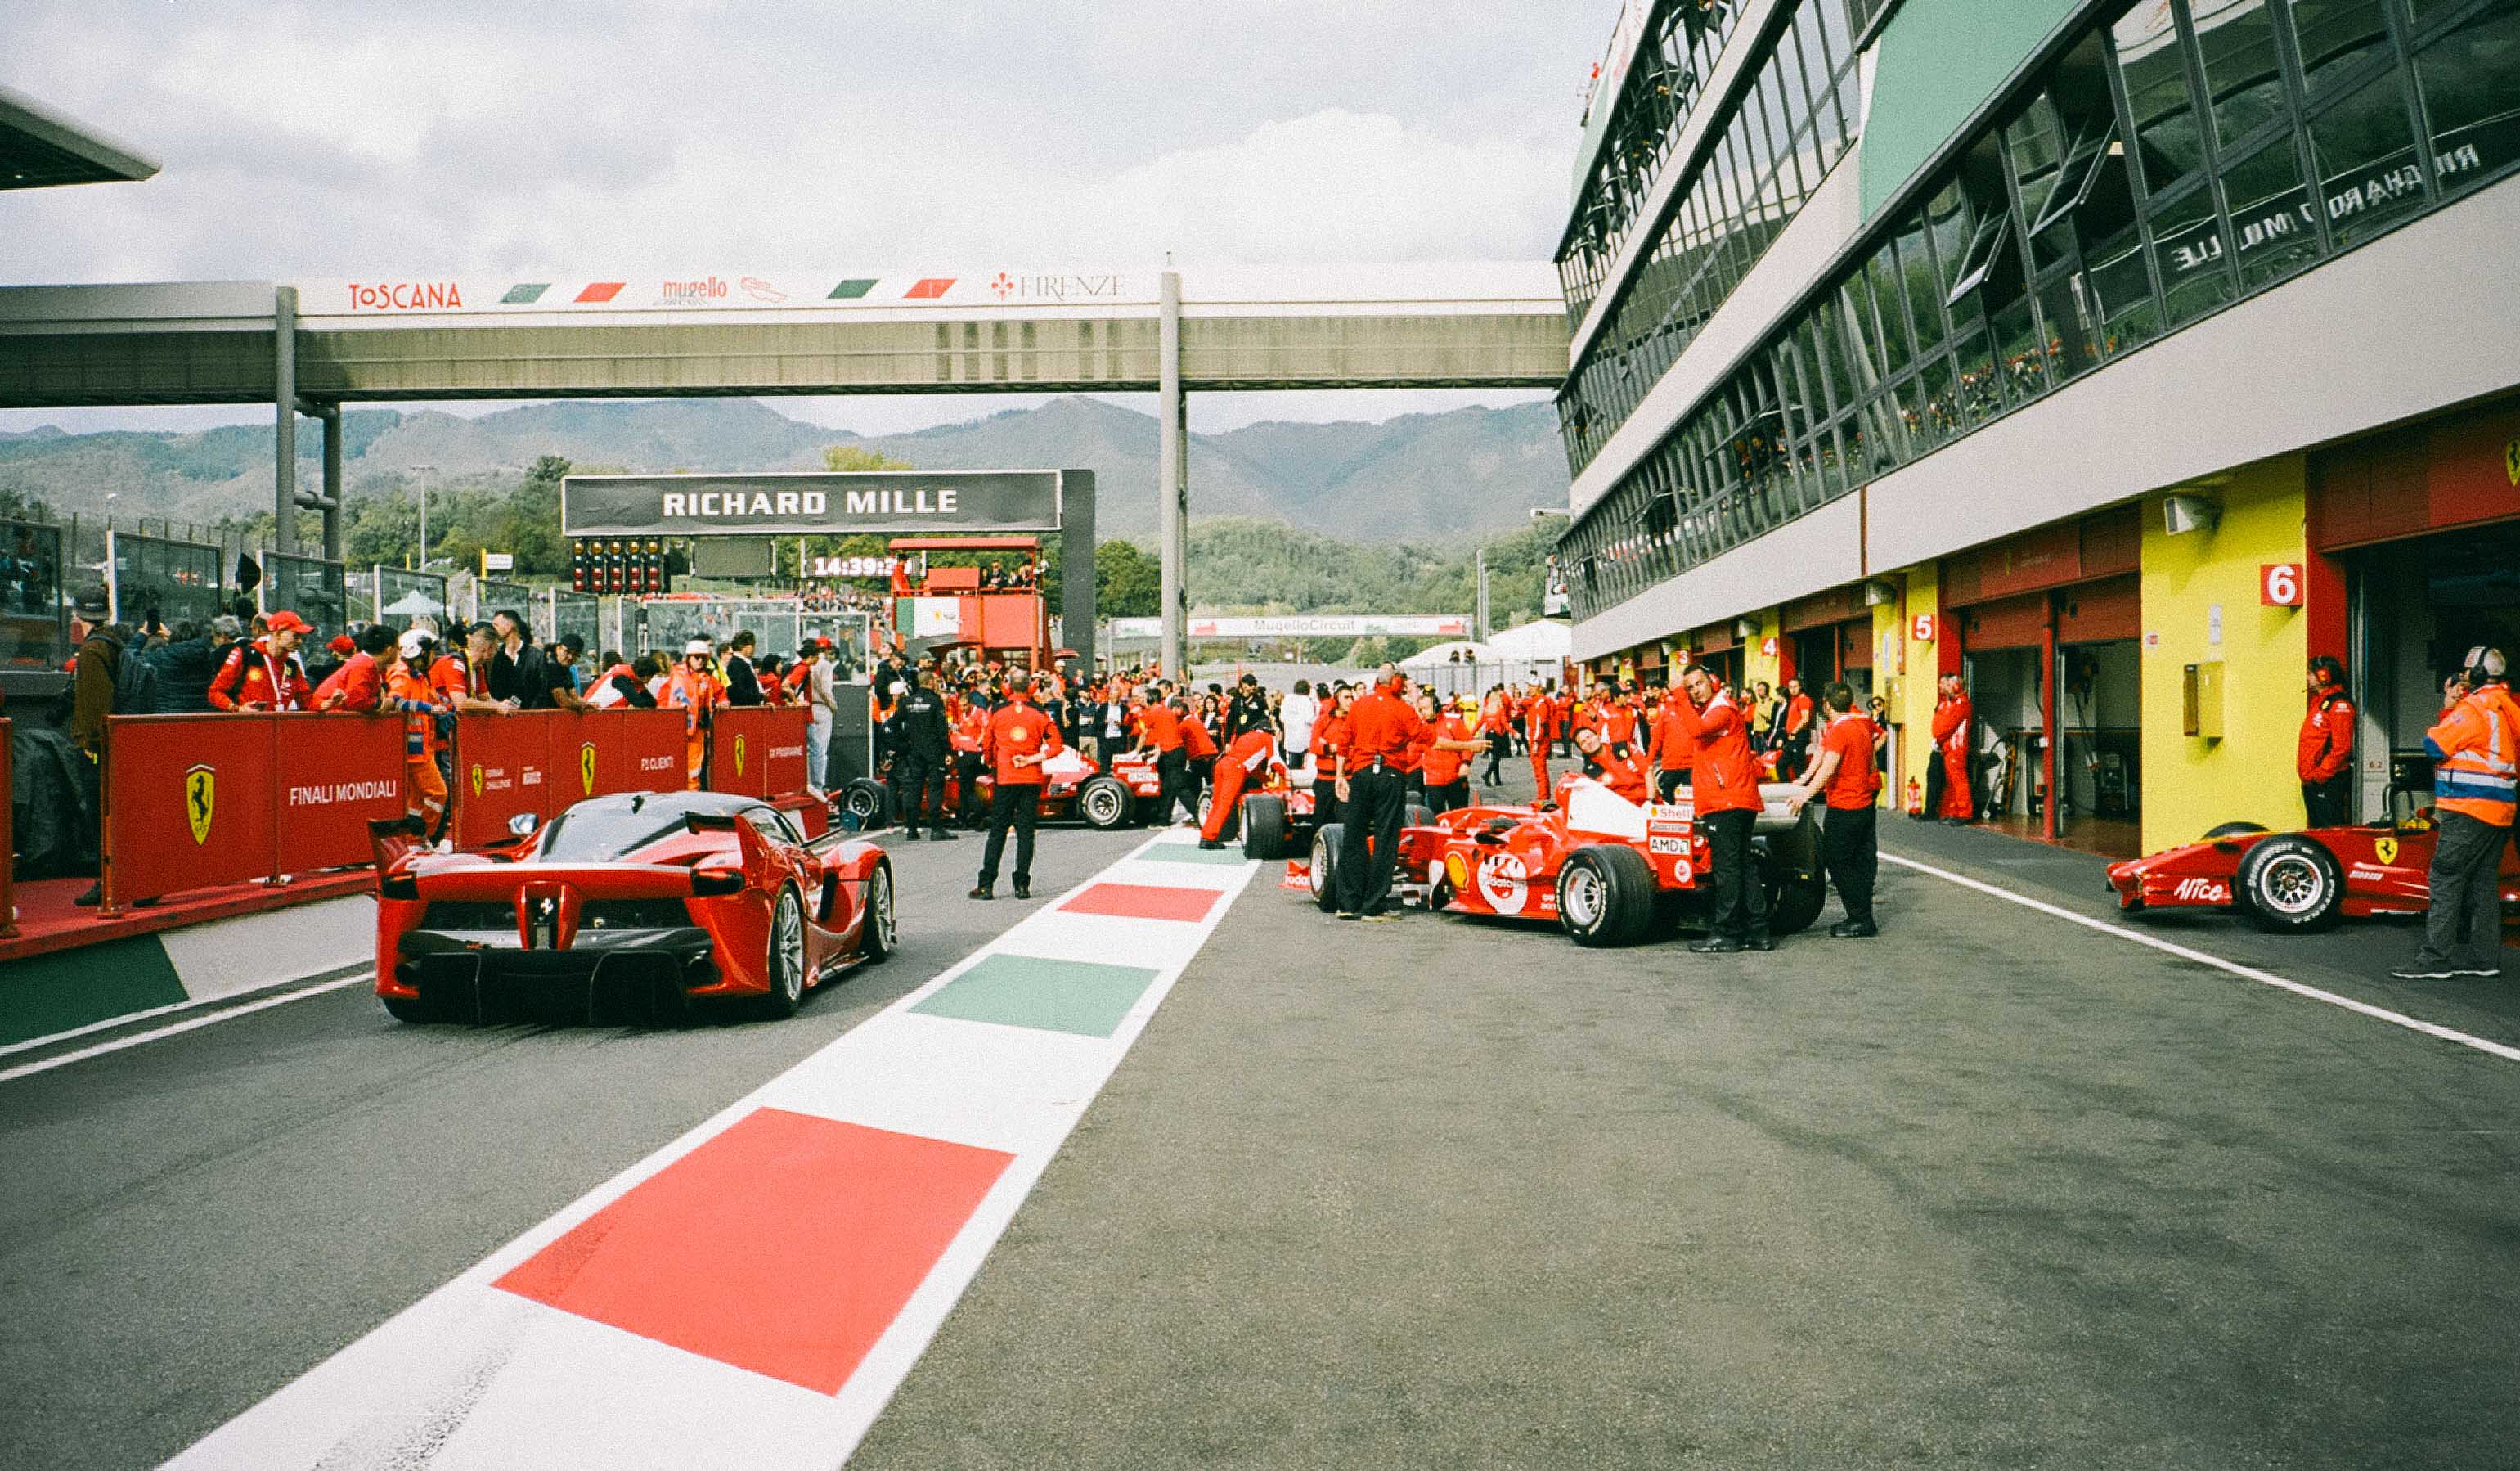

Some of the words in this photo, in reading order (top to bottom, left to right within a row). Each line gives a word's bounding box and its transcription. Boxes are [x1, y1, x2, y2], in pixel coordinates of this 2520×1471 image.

[663, 276, 727, 299] mugello
[1020, 274, 1127, 301] FIRENZE
[663, 492, 826, 517] RICHARD
[847, 488, 958, 514] MILLE
[2269, 565, 2296, 604] 6
[1916, 614, 1933, 640] 5
[1763, 637, 1777, 655] 4
[290, 785, 333, 807] FINALI
[336, 781, 397, 803] MONDIALI
[1660, 807, 1690, 818] Shell
[1651, 839, 1678, 852] AMD
